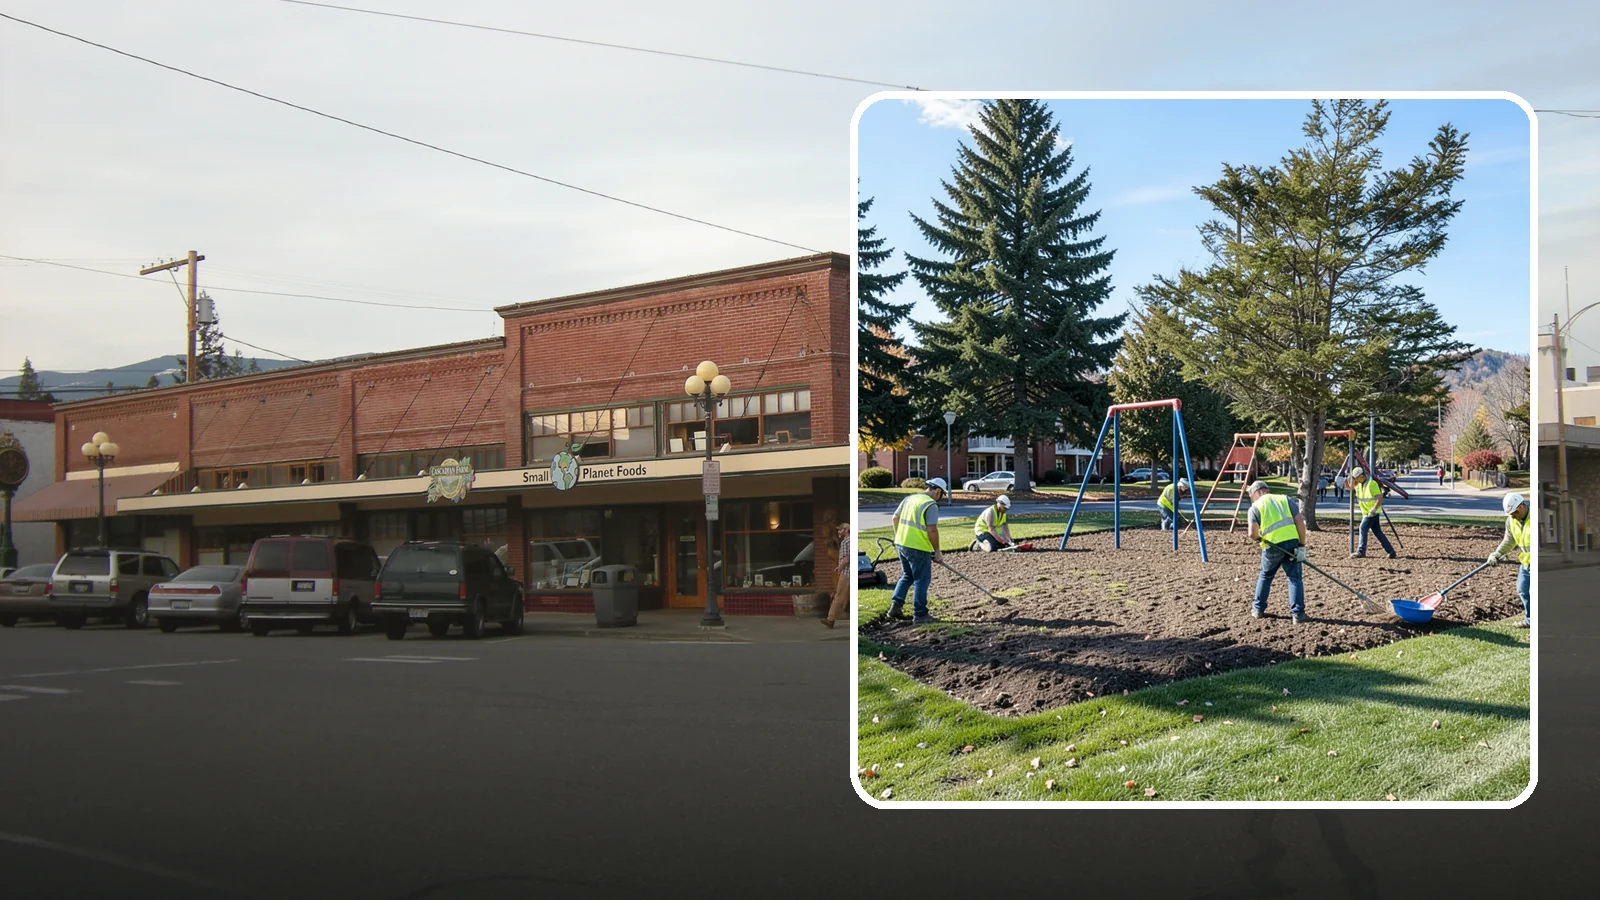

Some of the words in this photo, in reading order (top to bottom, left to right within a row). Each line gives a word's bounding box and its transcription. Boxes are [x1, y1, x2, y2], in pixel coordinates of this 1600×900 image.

[456, 465, 469, 475] FARM
[523, 471, 549, 482] Small
[583, 467, 614, 479] Planet
[617, 464, 647, 477] Foods
